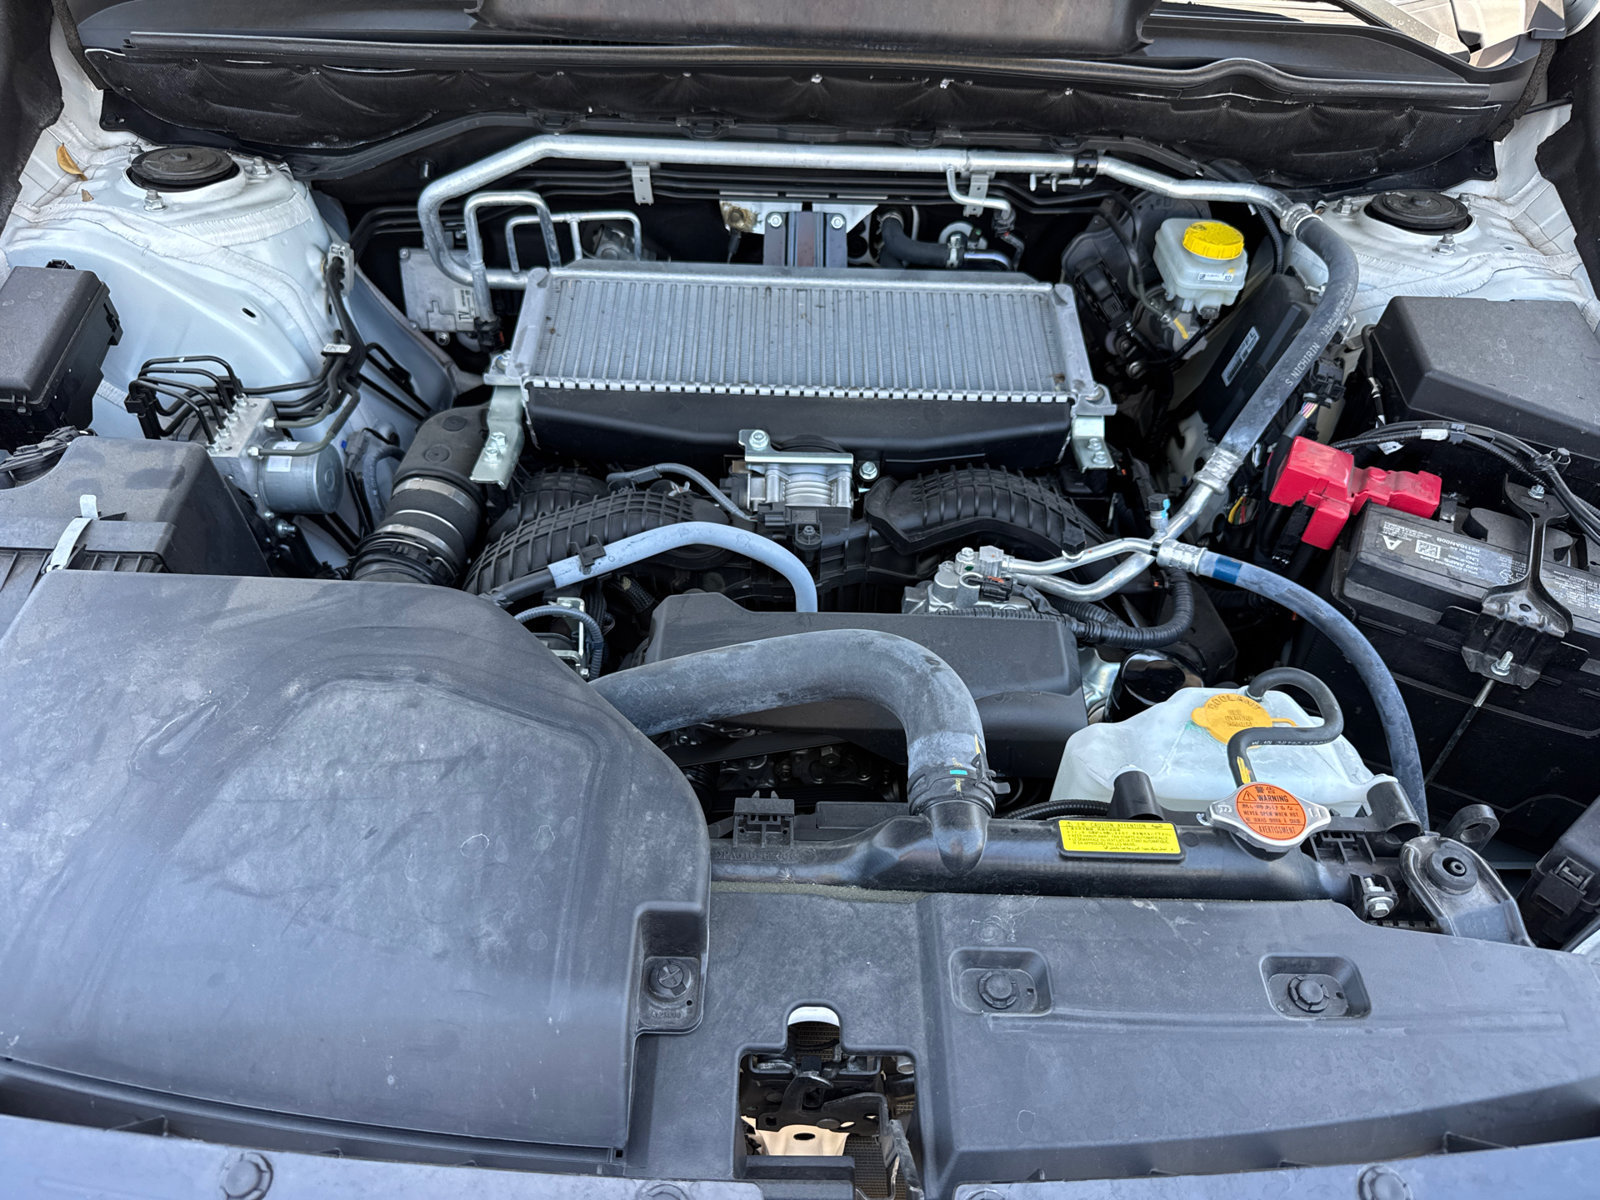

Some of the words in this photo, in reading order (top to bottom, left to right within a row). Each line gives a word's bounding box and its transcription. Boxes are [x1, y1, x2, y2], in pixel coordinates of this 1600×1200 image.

[1291, 342, 1321, 379] NICHIRIN
[1207, 694, 1261, 710] COOLANT
[1257, 794, 1289, 802] WARNING
